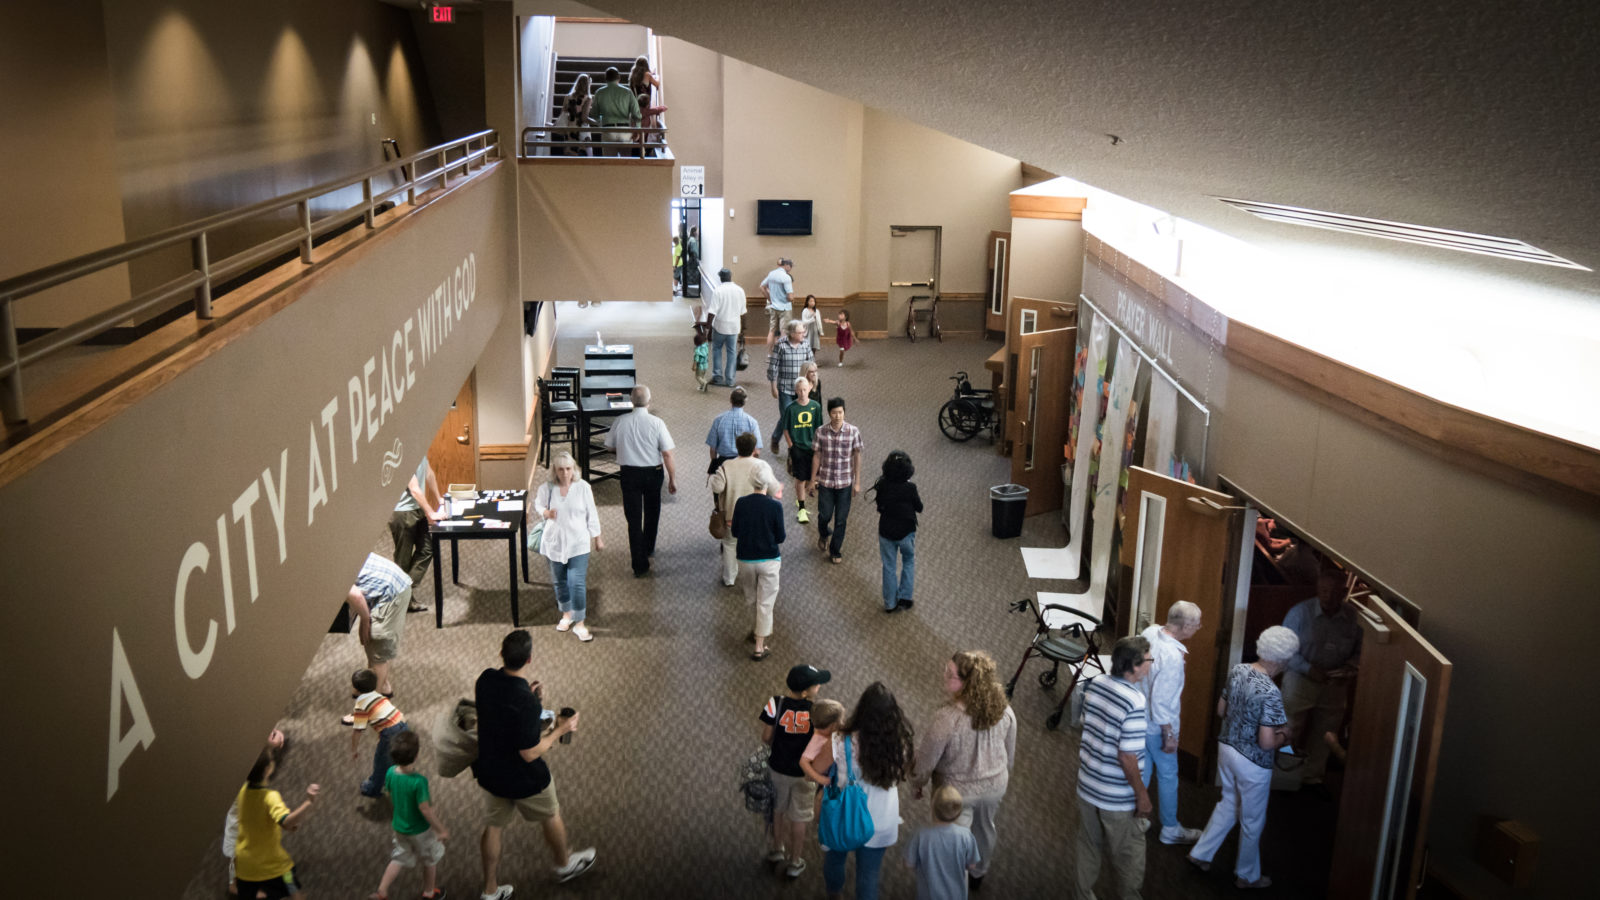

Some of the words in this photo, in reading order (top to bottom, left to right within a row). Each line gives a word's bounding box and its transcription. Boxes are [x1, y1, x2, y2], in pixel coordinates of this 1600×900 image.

[433, 6, 452, 22] EXIT
[682, 184, 697, 195] C2
[1117, 290, 1146, 342] PRAYER
[1149, 313, 1173, 365] WALL
[798, 411, 813, 424] O
[107, 627, 155, 801] A
[175, 449, 289, 680] CITY
[307, 397, 340, 526] AT
[348, 318, 417, 464] PEACE
[418, 276, 453, 368] WITH
[454, 252, 477, 321] GOD
[779, 709, 810, 733] 45
